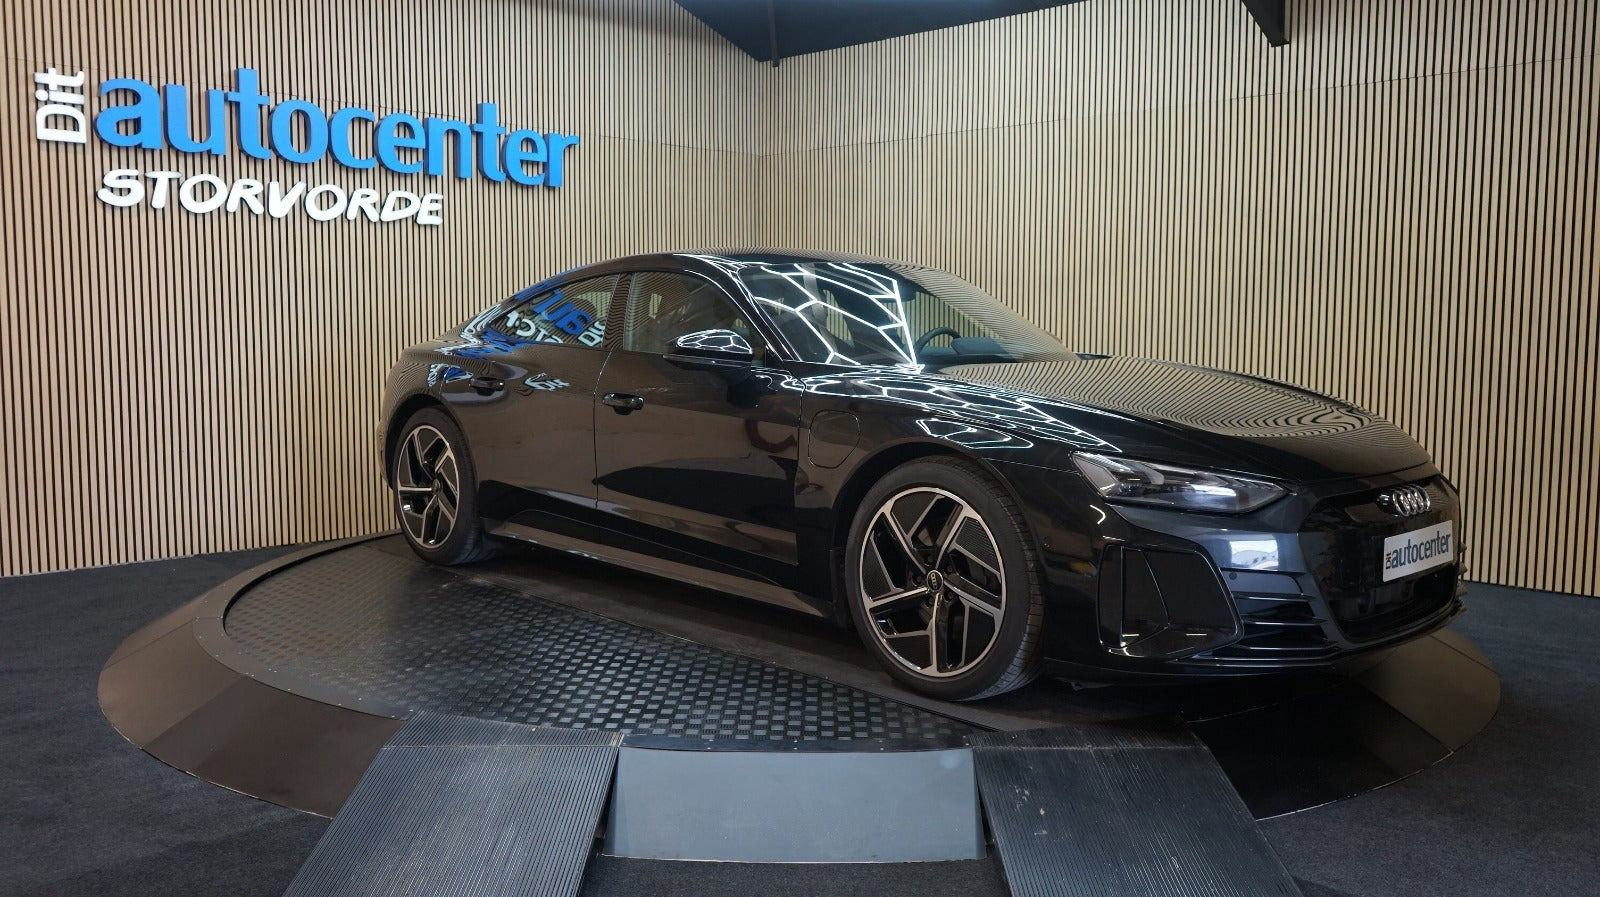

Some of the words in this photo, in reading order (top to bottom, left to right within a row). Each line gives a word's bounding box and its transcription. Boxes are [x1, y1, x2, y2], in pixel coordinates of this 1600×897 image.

[35, 67, 87, 143] Dit
[95, 68, 579, 188] autocenter
[97, 168, 444, 226] STORVORDE
[1391, 531, 1451, 569] autocenter
